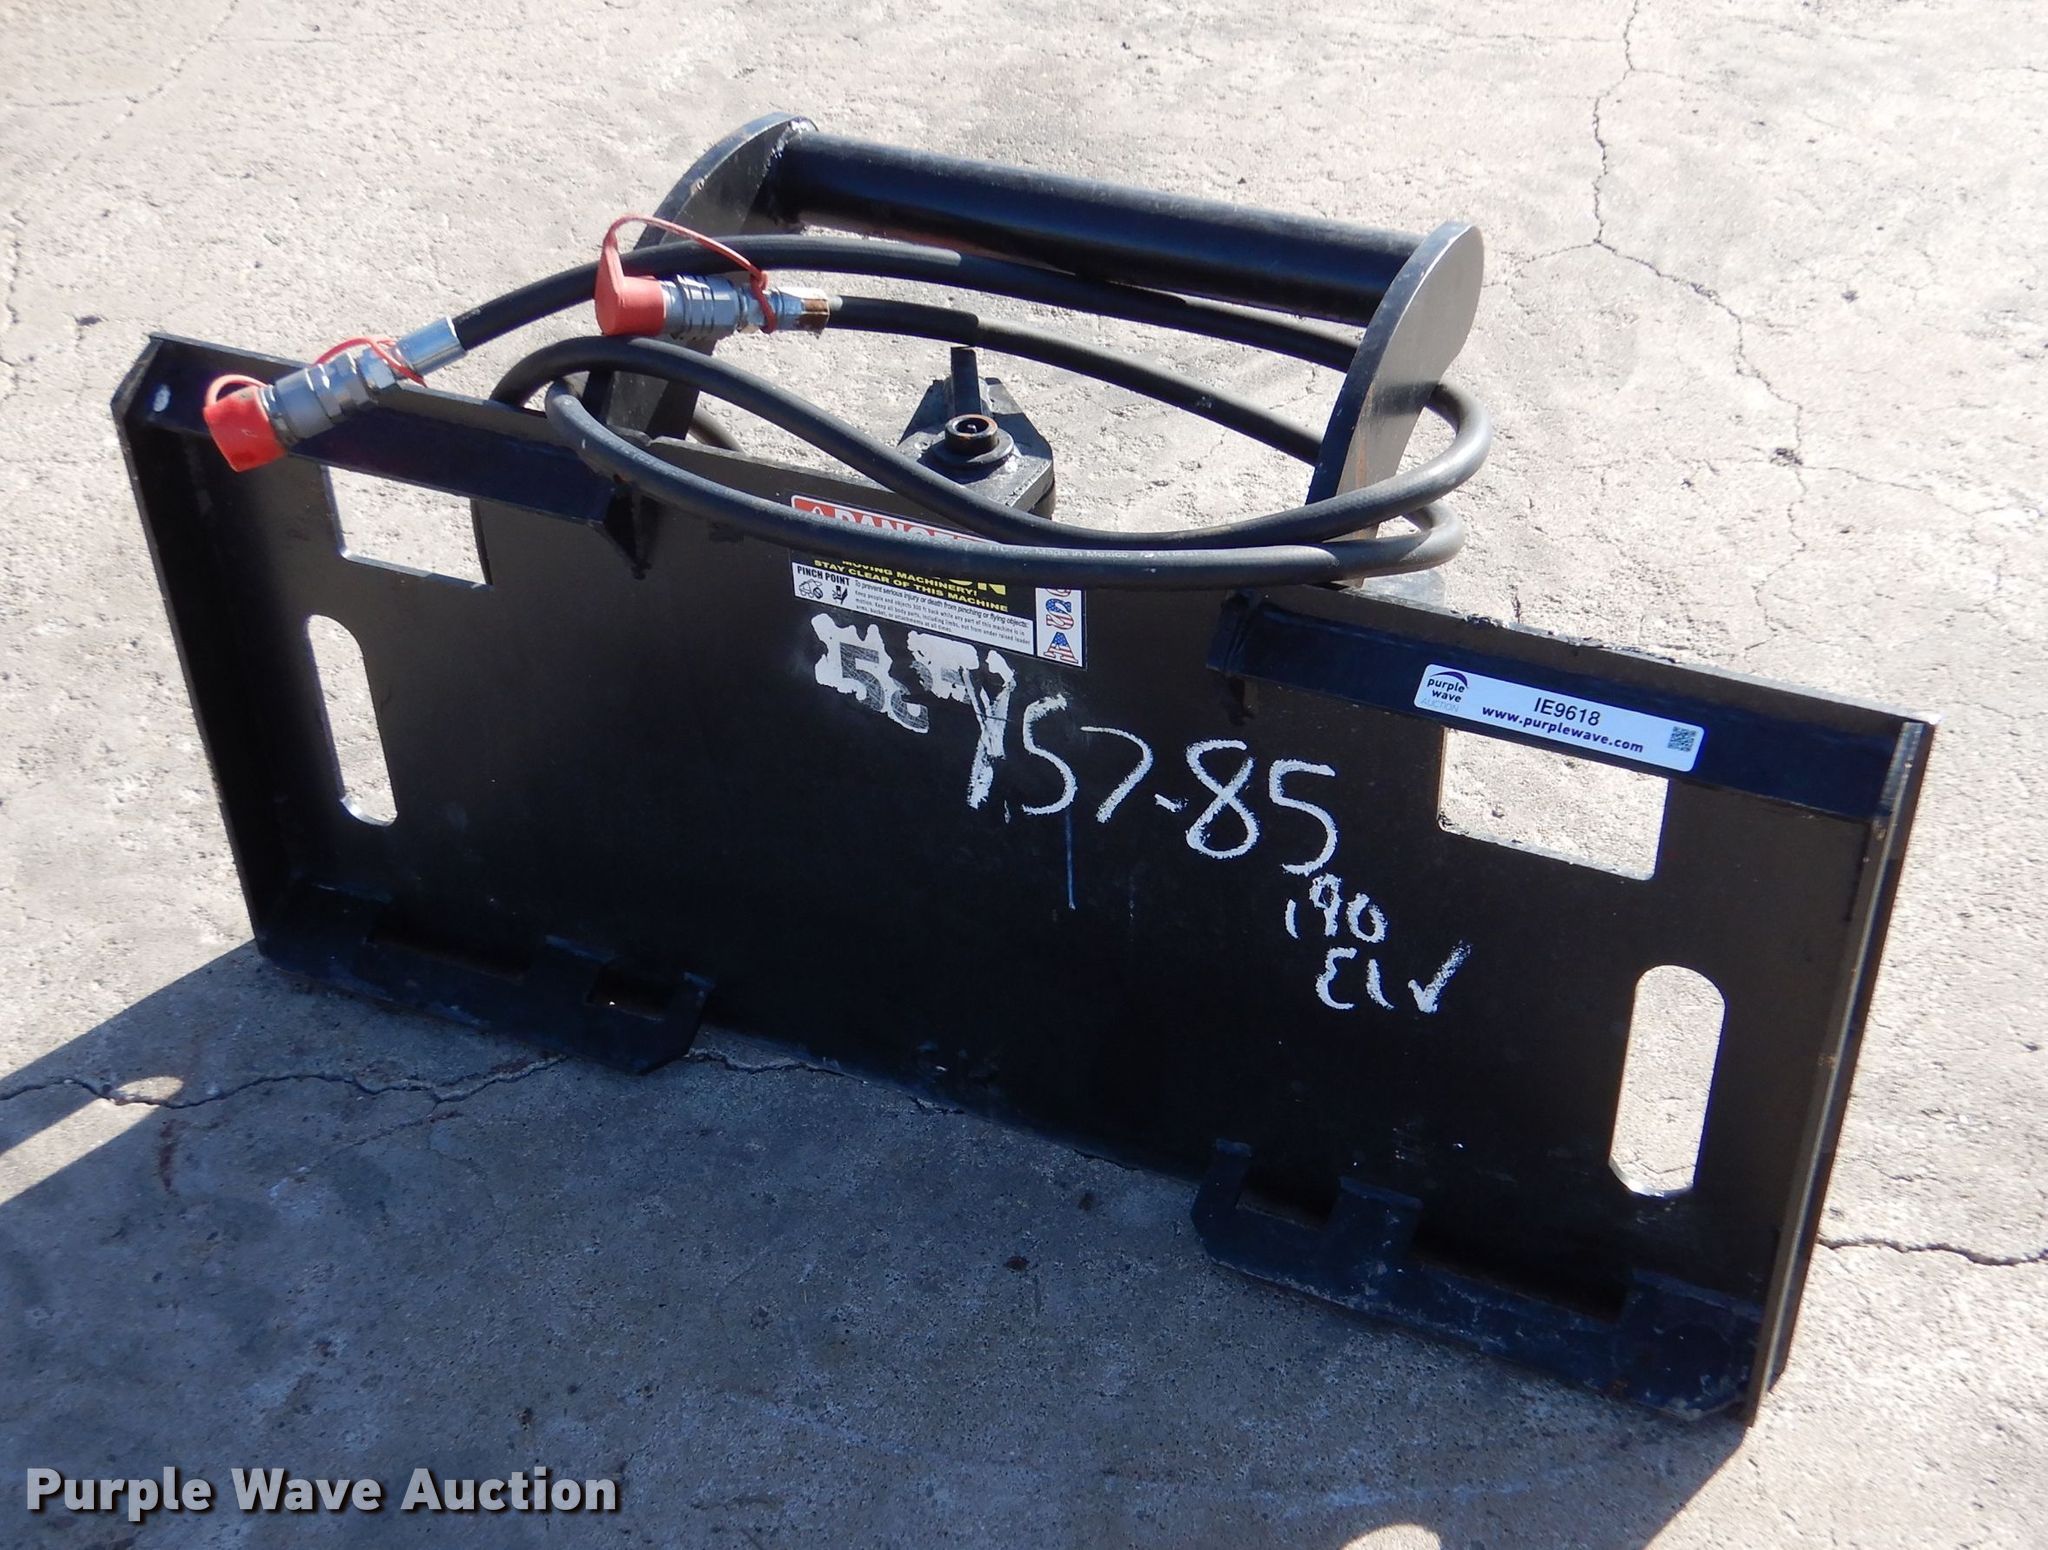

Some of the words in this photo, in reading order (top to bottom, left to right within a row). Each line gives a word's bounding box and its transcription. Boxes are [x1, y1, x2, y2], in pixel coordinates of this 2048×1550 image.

[797, 565, 823, 579] PINCH
[825, 571, 849, 586] POINT
[814, 560, 845, 573] STAY
[848, 568, 890, 584] CLEAR
[893, 579, 910, 588] OF
[914, 584, 943, 597] THIS
[948, 592, 1008, 613] MACHINE
[896, 571, 977, 597] MACHINERY!
[862, 583, 881, 592] prevent
[883, 587, 901, 596] serious
[904, 593, 919, 602] injury
[927, 598, 942, 607] death
[944, 602, 956, 610] from
[957, 606, 981, 617] pinching
[990, 613, 1004, 623] flying
[895, 600, 911, 608] objects
[993, 624, 1012, 633] machine
[922, 614, 943, 624] including
[1043, 588, 1079, 664] SA
[1427, 678, 1465, 693] purple
[1431, 689, 1462, 703] wave
[1420, 698, 1459, 713] AUCTION
[1534, 697, 1601, 726] IE9618
[1482, 705, 1644, 753] www.purplewave.com
